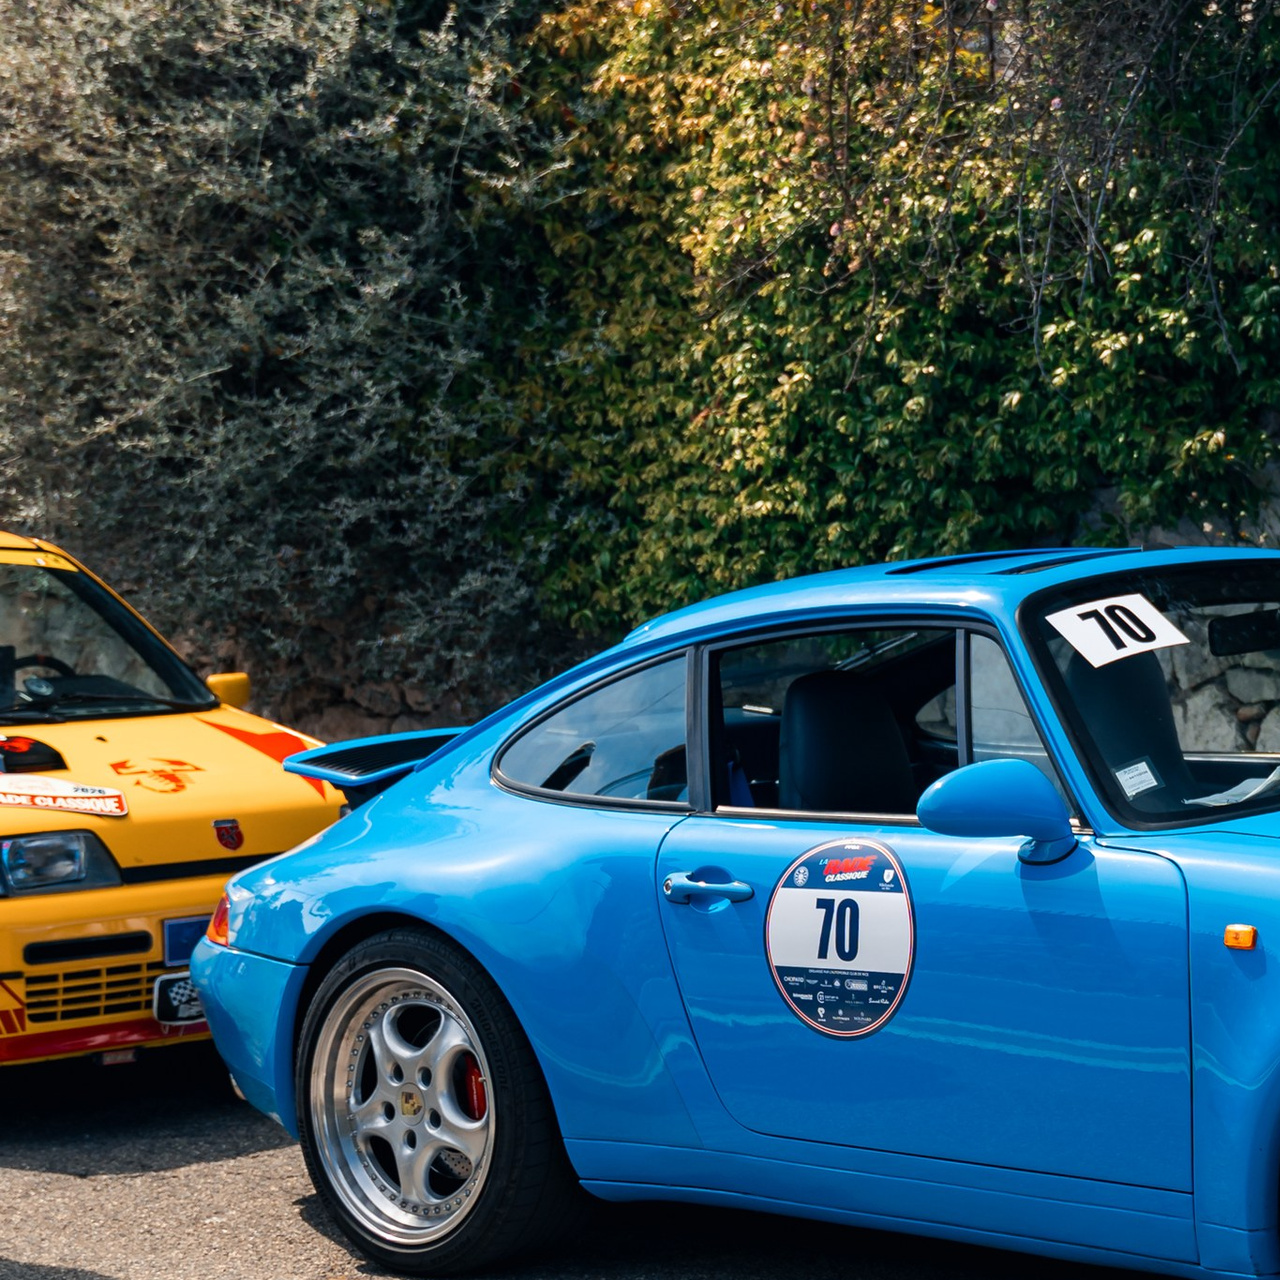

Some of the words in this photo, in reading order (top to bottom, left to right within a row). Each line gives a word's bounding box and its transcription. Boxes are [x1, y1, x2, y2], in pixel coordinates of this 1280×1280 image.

[1077, 604, 1156, 651] 70
[34, 797, 121, 812] CLASSIQUE
[823, 855, 878, 875] RADE
[825, 871, 869, 883] CLASSIQUE
[815, 898, 860, 962] 70
